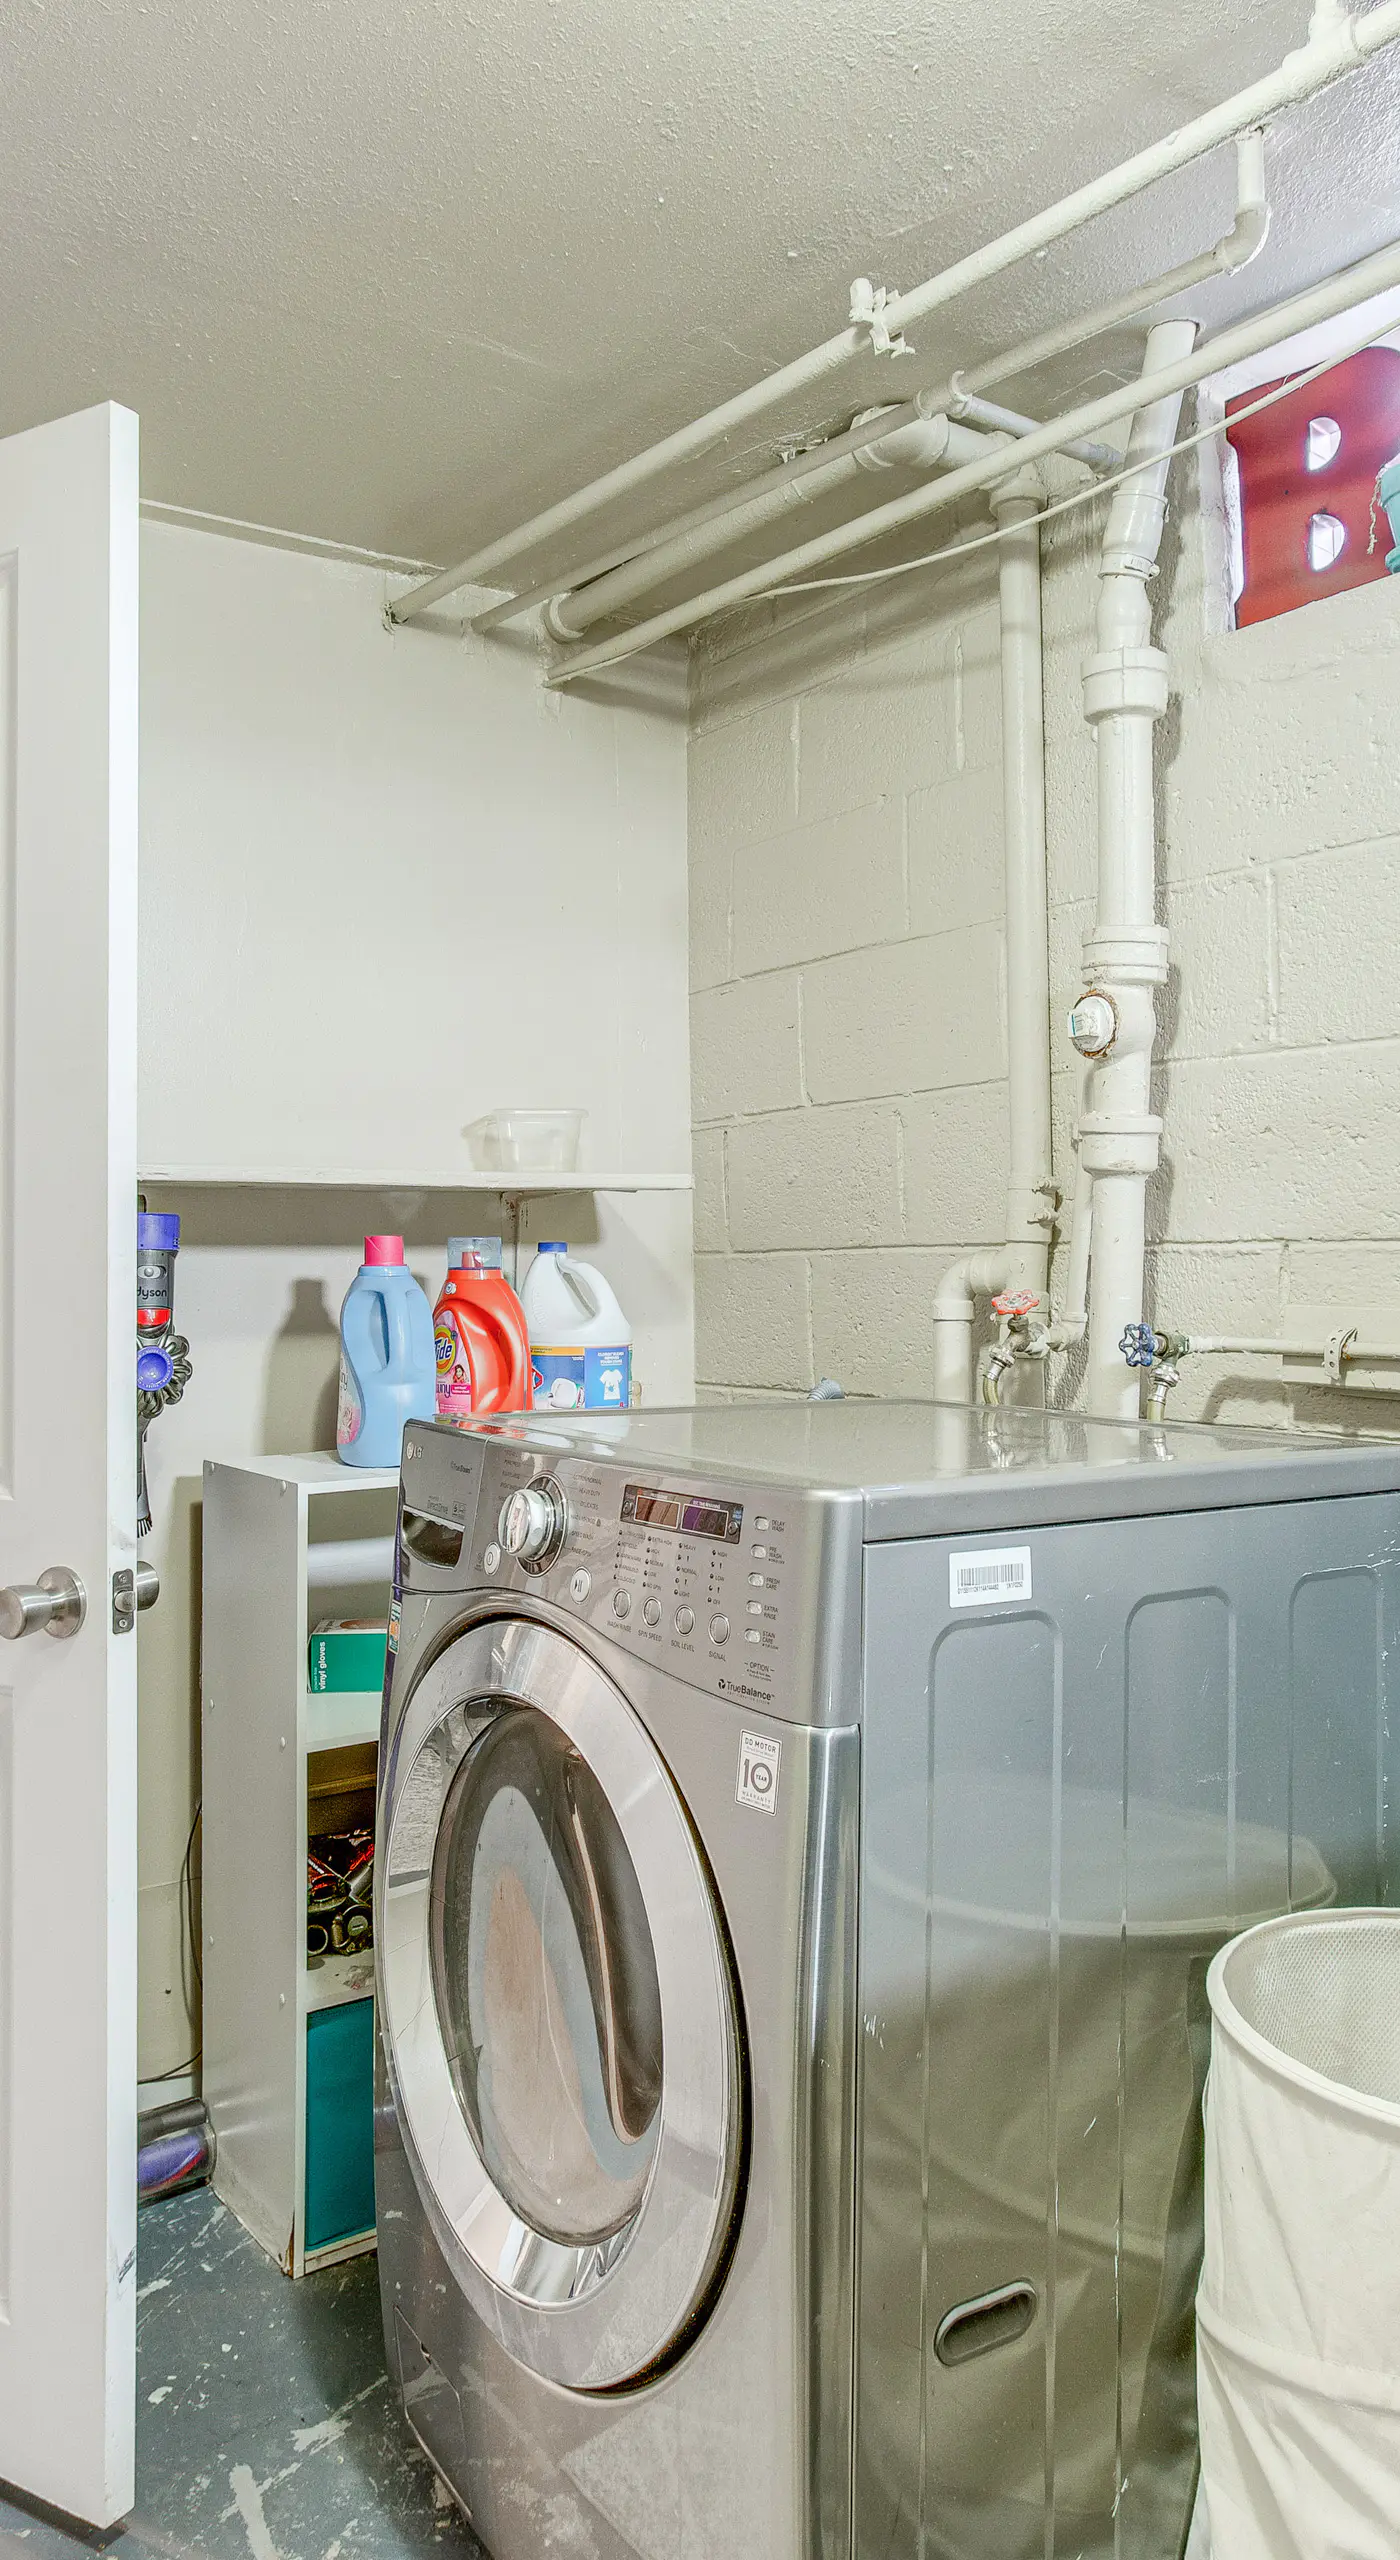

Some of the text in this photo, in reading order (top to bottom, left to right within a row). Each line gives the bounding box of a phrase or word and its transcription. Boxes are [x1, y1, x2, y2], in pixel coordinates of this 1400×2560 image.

[137, 1286, 168, 1300] dyson
[435, 1339, 453, 1361] Tide
[763, 1605, 779, 1613] EXTRA
[638, 1629, 662, 1642] SPIN SPEED
[671, 1639, 695, 1653] SOIL LEVEL
[708, 1650, 726, 1662] SIGNAL
[318, 1641, 328, 1690] vinyl gloves
[749, 1661, 769, 1672] OPTION
[754, 1741, 777, 1754] MOTOR
[743, 1758, 773, 1794] 10
[755, 1774, 767, 1782] YEAR
